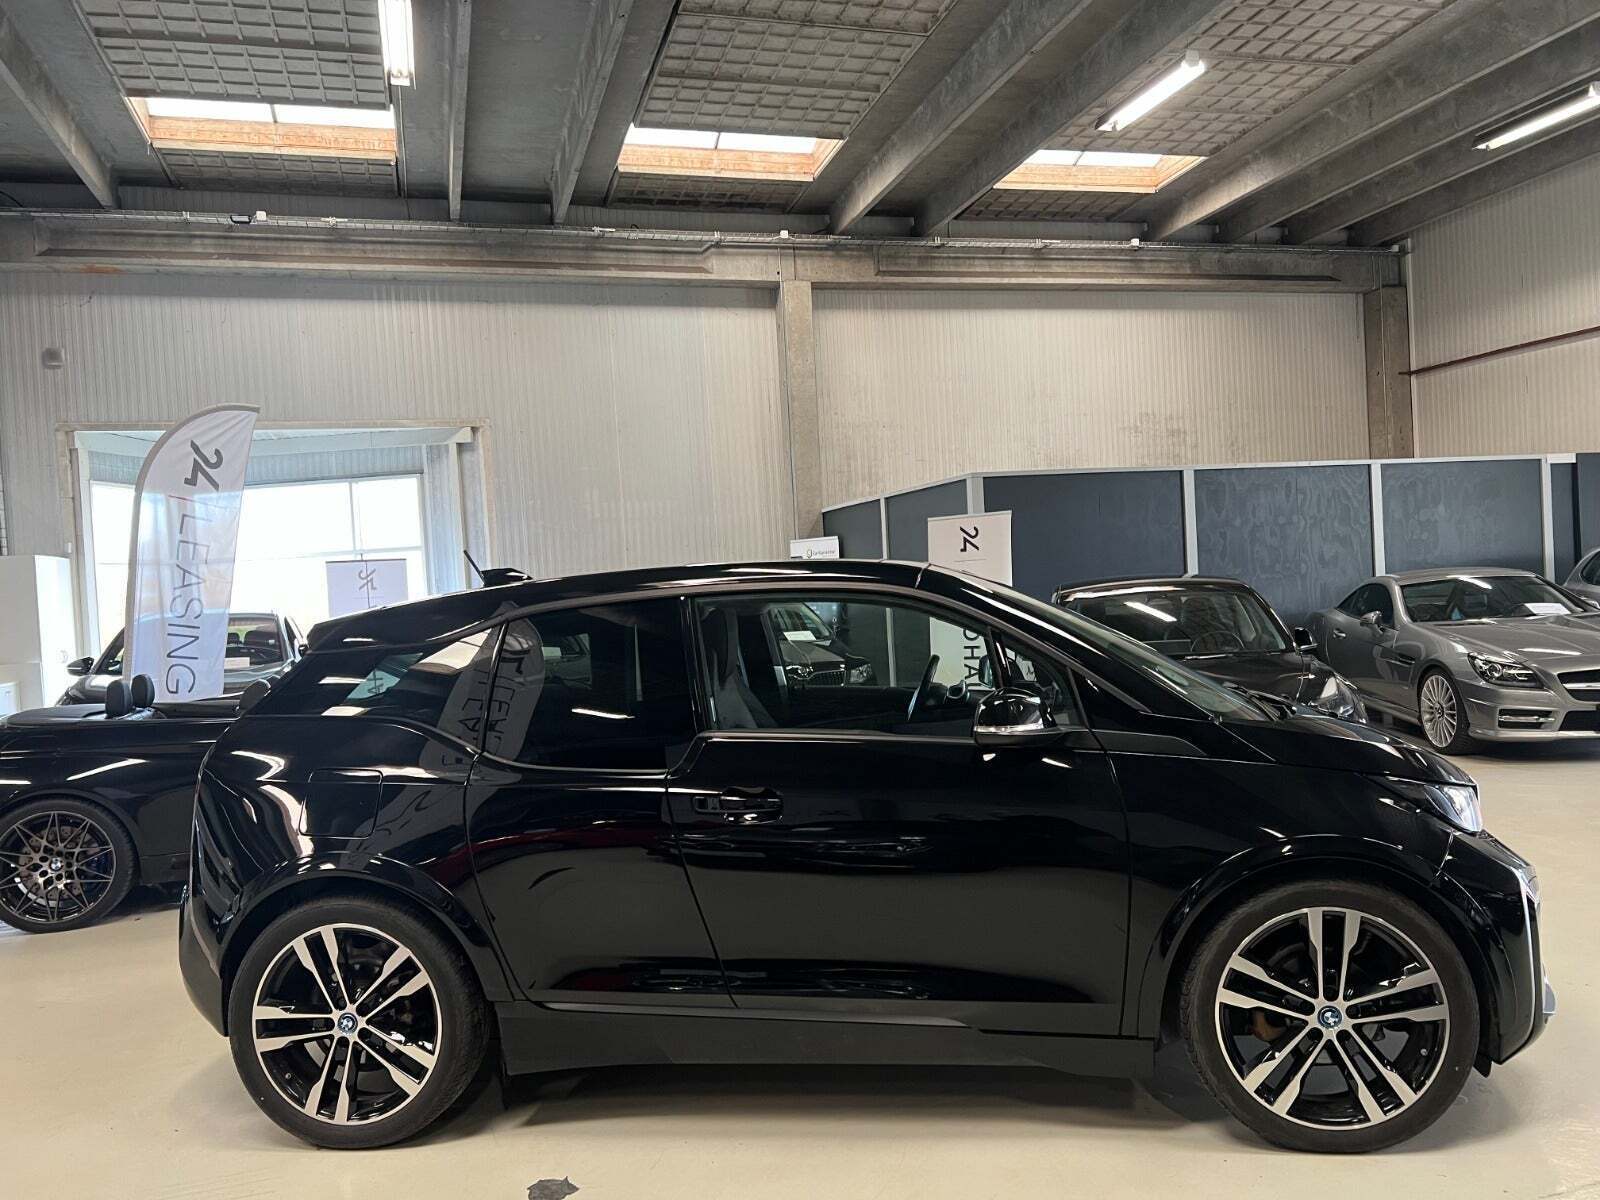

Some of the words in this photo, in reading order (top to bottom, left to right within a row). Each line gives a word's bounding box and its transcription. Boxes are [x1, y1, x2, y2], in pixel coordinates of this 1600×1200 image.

[184, 440, 224, 491] 24
[959, 525, 980, 552] 24
[165, 510, 213, 694] LEASING
